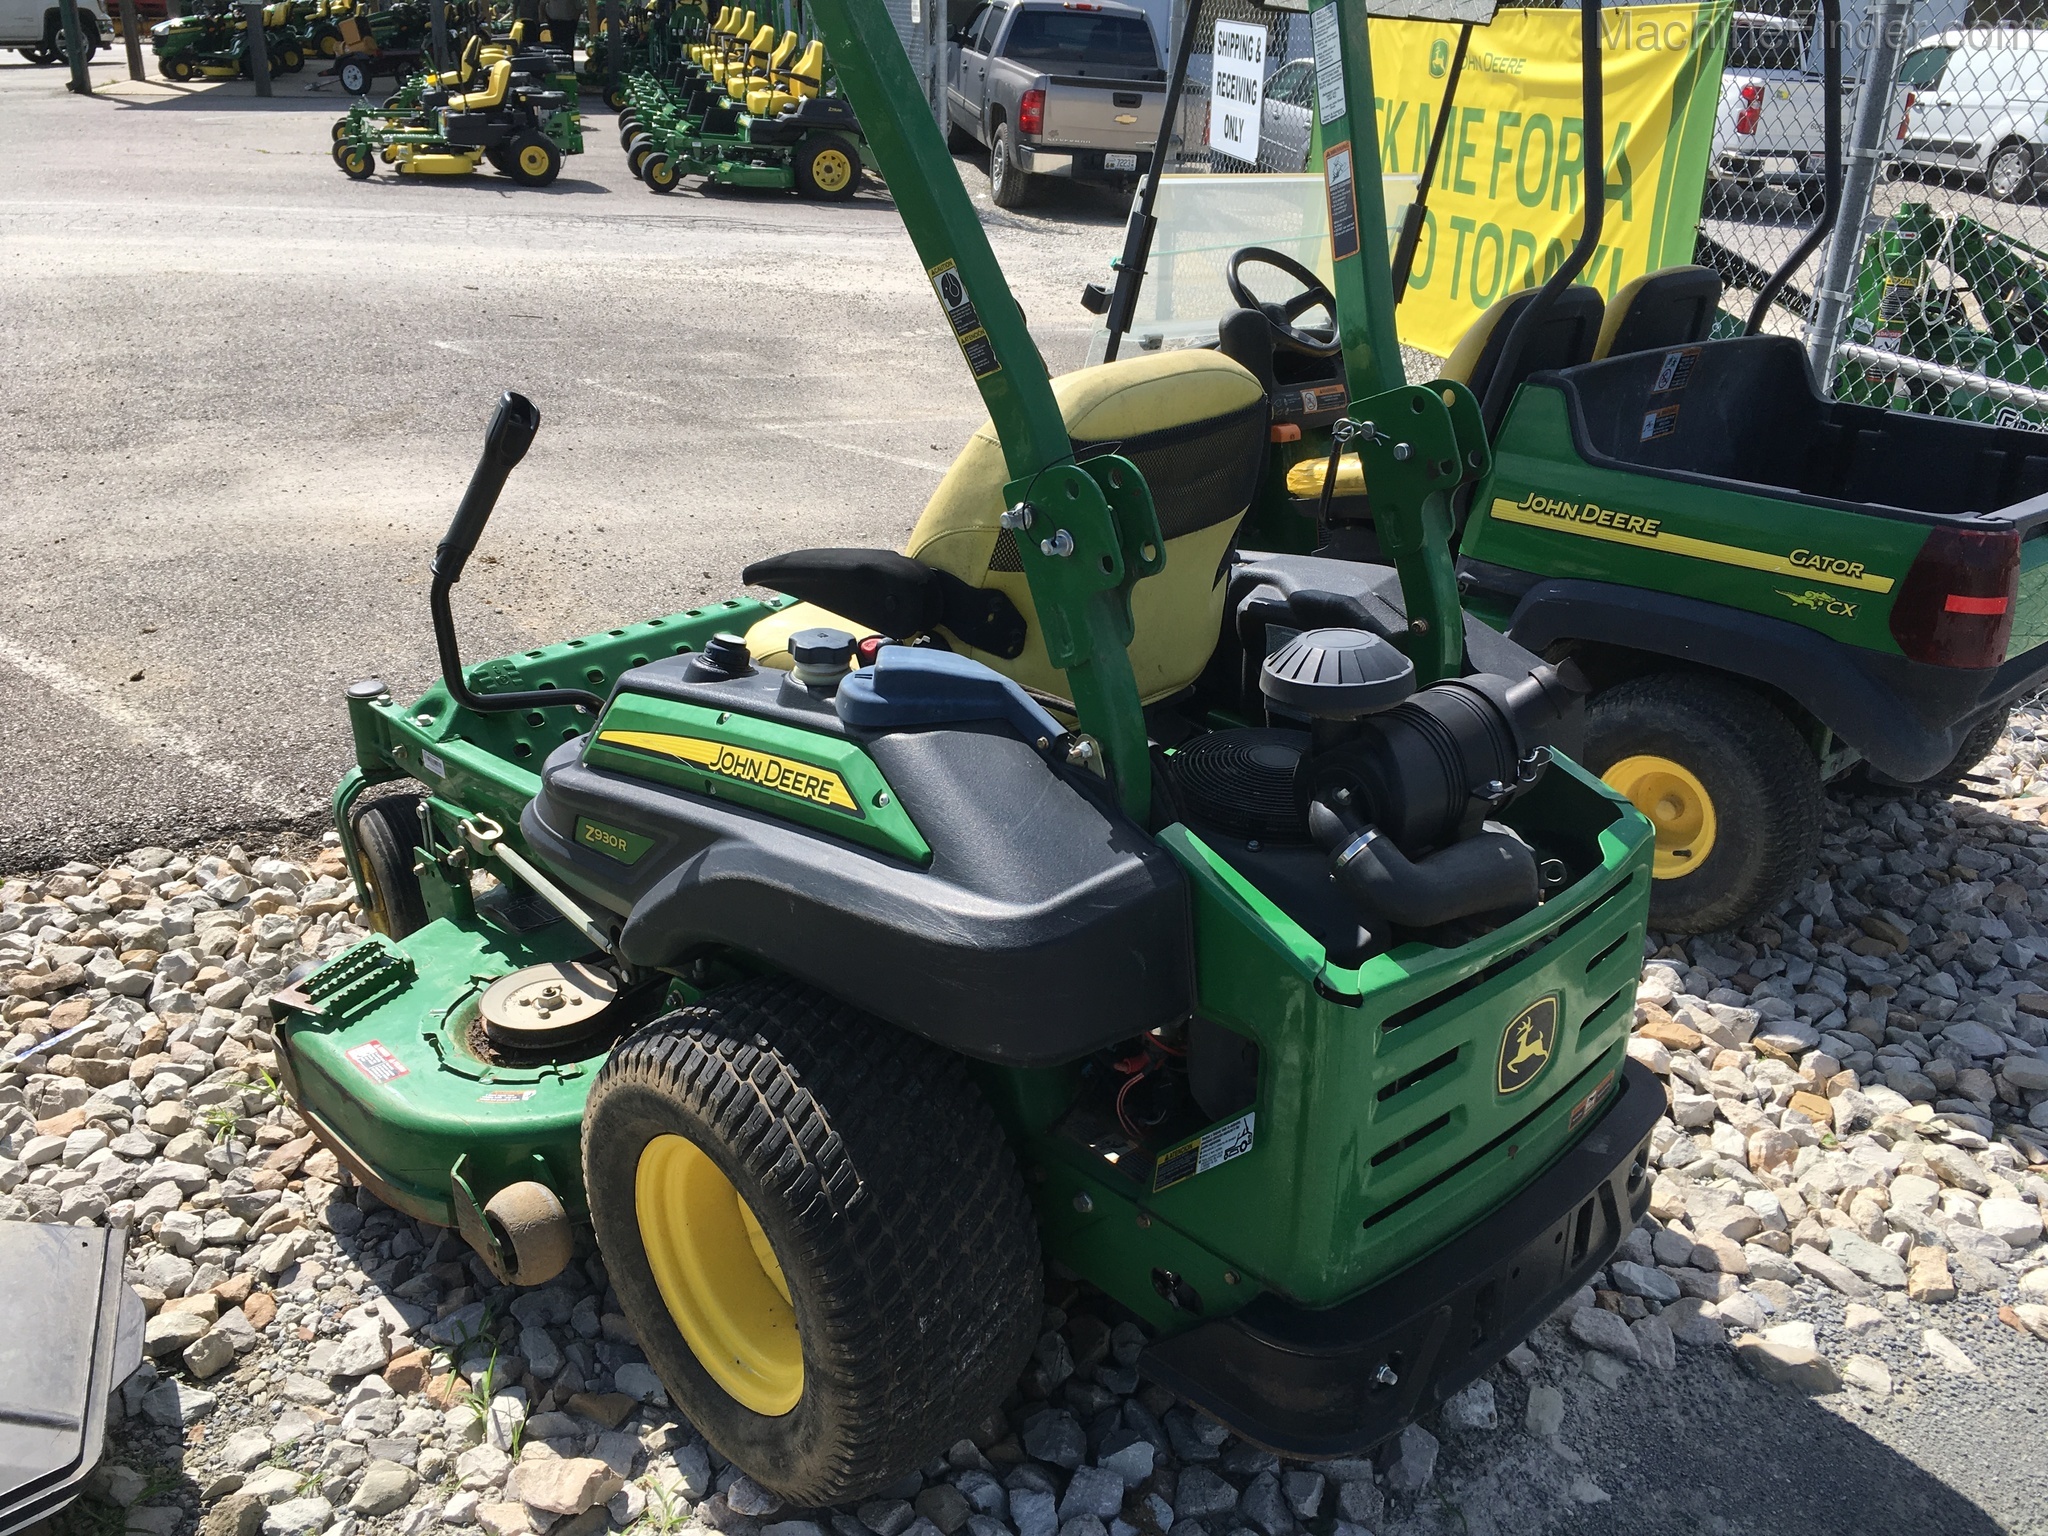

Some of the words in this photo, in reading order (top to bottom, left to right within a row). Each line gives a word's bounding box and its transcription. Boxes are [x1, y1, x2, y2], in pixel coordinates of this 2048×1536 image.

[1217, 30, 1254, 62] SHIPPING
[1255, 37, 1262, 63] &
[1461, 53, 1483, 72] OHN
[1483, 52, 1527, 74] DEERE
[1216, 71, 1258, 106] RECEIVING
[1223, 114, 1245, 143] ONLY
[1412, 102, 1486, 195] ME
[1489, 111, 1585, 215] FOR
[1603, 122, 1633, 222] A
[1450, 215, 1624, 310] TODAY!
[1517, 492, 1579, 521] JOHN
[1580, 503, 1661, 535] DEERE
[1789, 548, 1865, 579] GATOR
[1826, 600, 1859, 618] CX
[709, 745, 763, 782] JOHN
[764, 760, 835, 802] DEERE
[584, 824, 628, 852] Z930R
